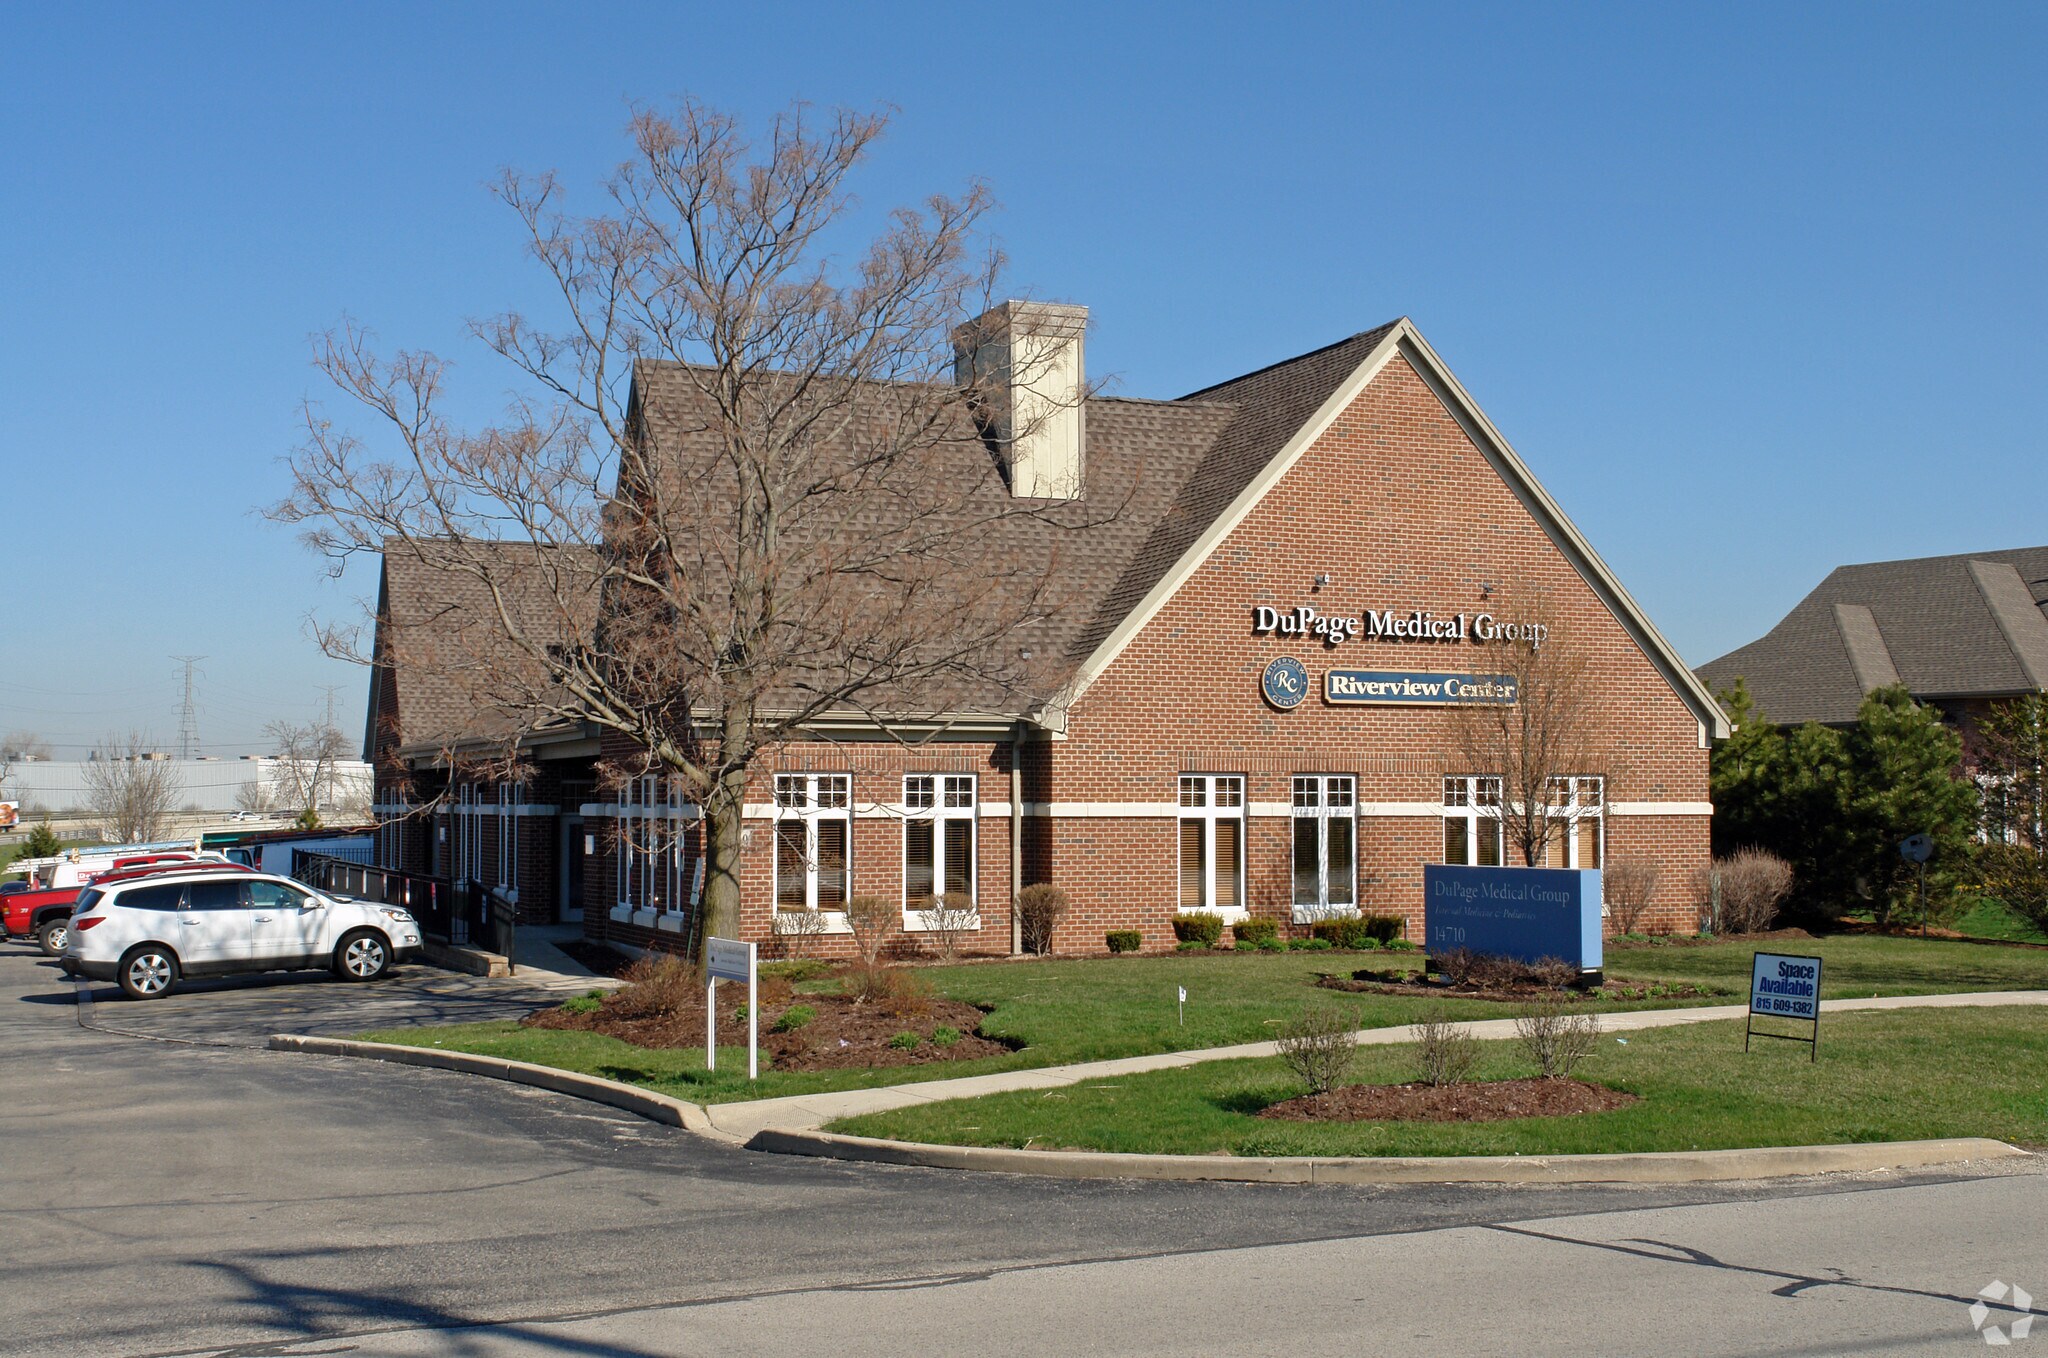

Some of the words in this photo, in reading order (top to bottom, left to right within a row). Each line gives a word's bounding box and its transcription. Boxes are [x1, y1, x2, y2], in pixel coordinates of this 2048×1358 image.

[1256, 606, 1359, 643] DuPage
[1367, 609, 1465, 639] Medical
[1475, 613, 1549, 649] Group
[1266, 658, 1306, 676] RIVERVIEW
[1273, 669, 1299, 693] RC
[1330, 675, 1441, 698] Riverview
[1443, 678, 1515, 698] Center
[1272, 693, 1303, 706] CENTER
[1435, 881, 1478, 902] DuPage
[1481, 882, 1527, 900] Medical
[1531, 884, 1570, 908] Group
[1435, 926, 1466, 943] 14710
[1778, 961, 1815, 979] Space
[1759, 976, 1814, 997] Available
[1755, 997, 1771, 1010] 815
[1773, 999, 1812, 1014] 609-1382
